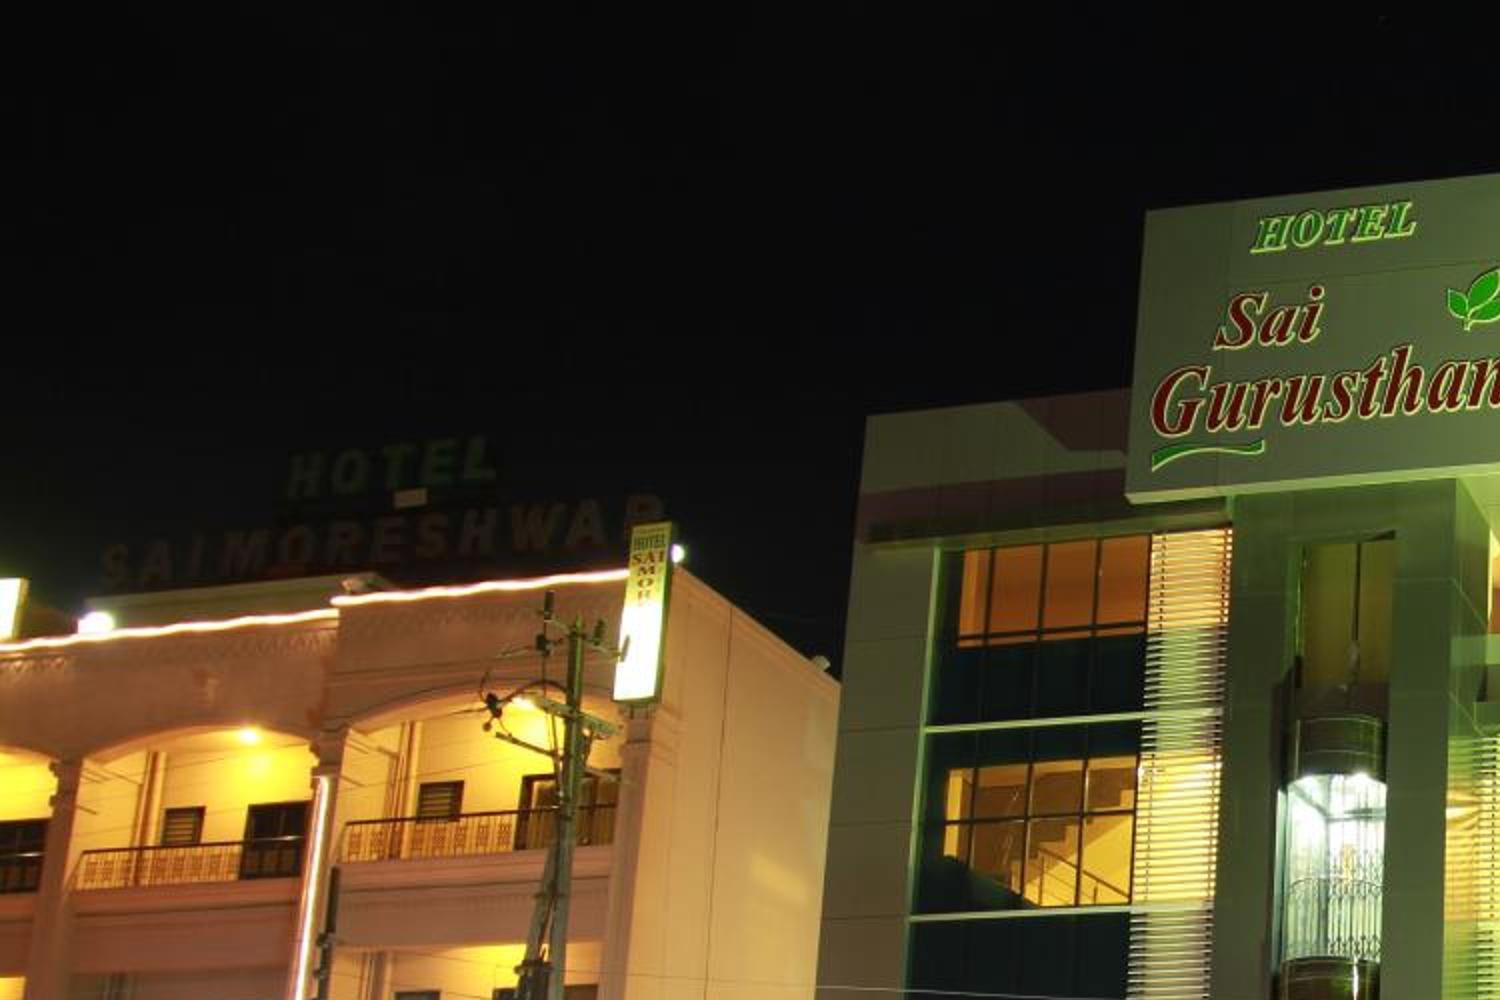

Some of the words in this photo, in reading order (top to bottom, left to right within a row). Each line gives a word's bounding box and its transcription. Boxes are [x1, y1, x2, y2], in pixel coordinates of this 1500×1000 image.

[1250, 201, 1417, 254] HOTEL
[1212, 285, 1326, 351] Sai
[286, 434, 498, 499] HOTEL
